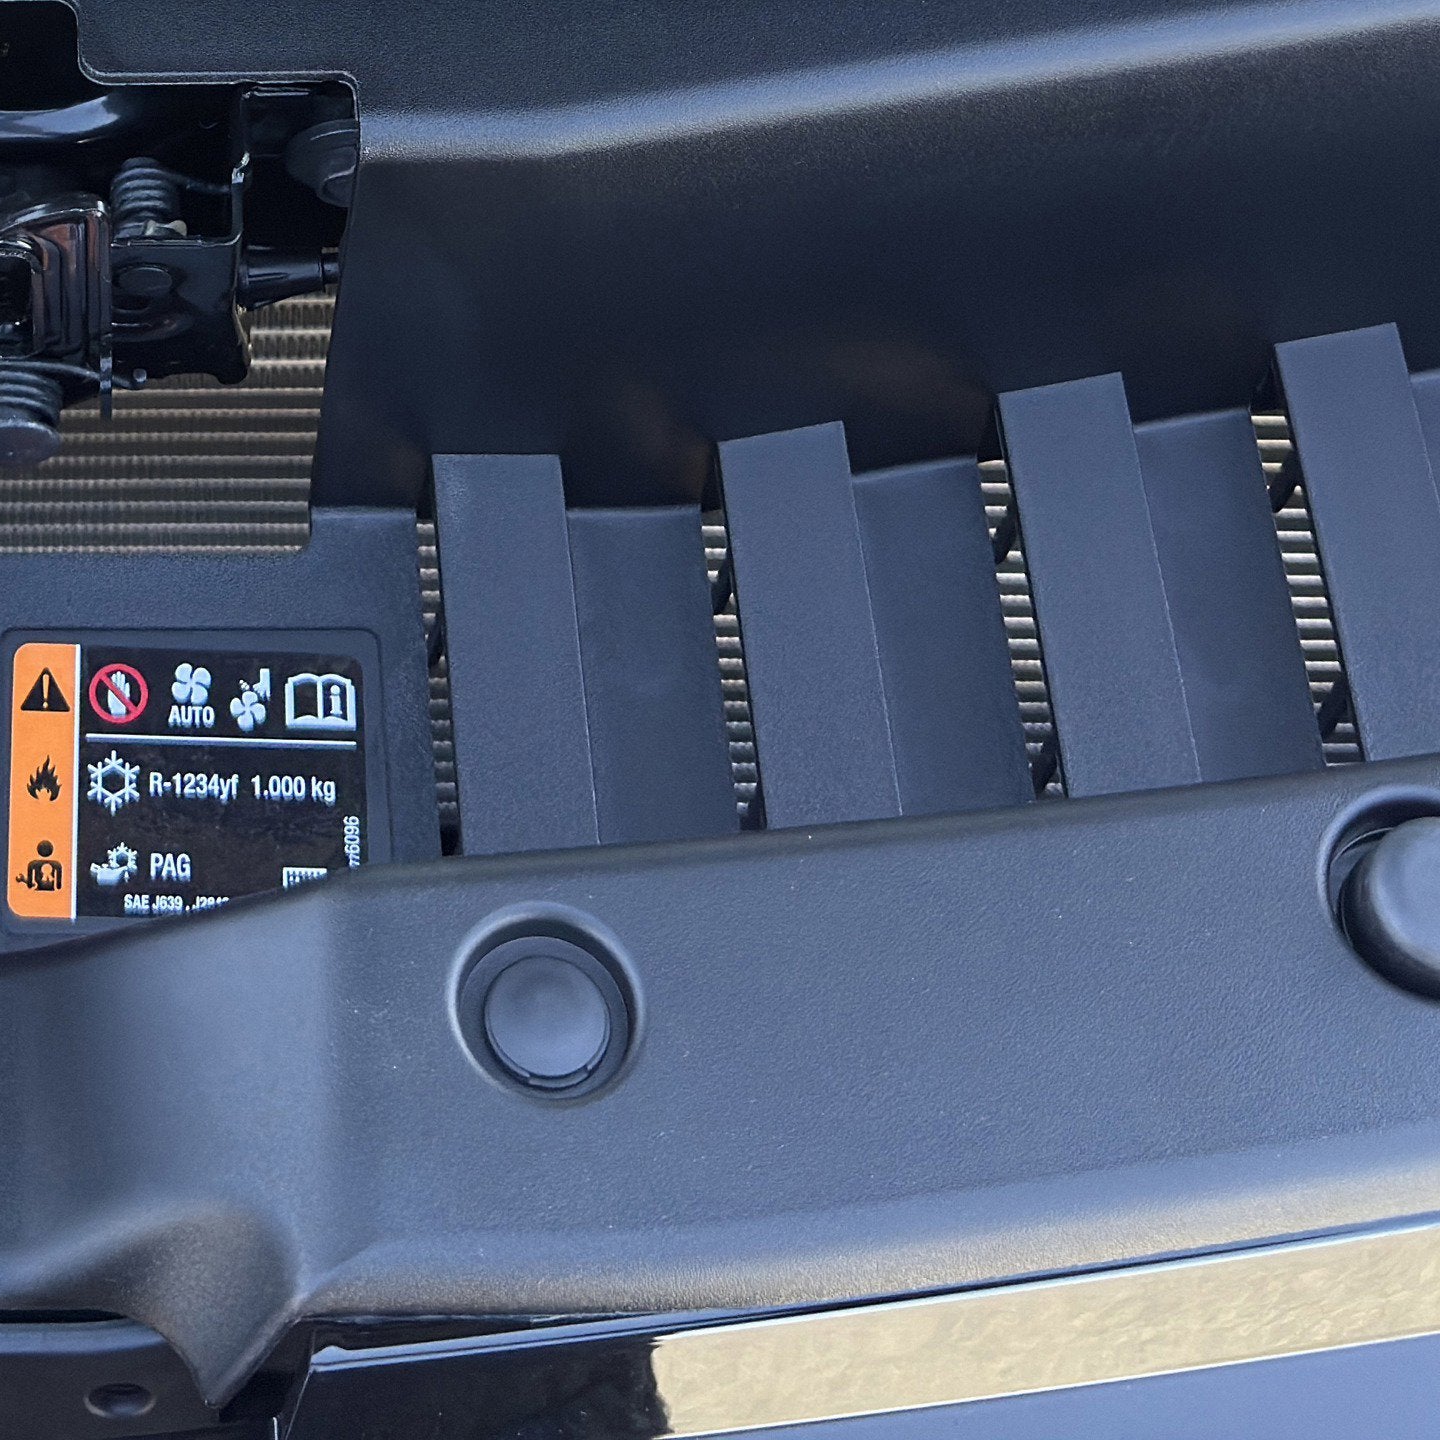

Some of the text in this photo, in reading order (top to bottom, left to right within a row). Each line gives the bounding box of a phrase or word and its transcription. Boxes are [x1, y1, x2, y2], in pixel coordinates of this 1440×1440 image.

[168, 706, 215, 727] AUTO
[149, 772, 337, 804] R-1234yf 1.000 kg
[150, 853, 191, 880] PAG
[124, 894, 150, 912] SAE
